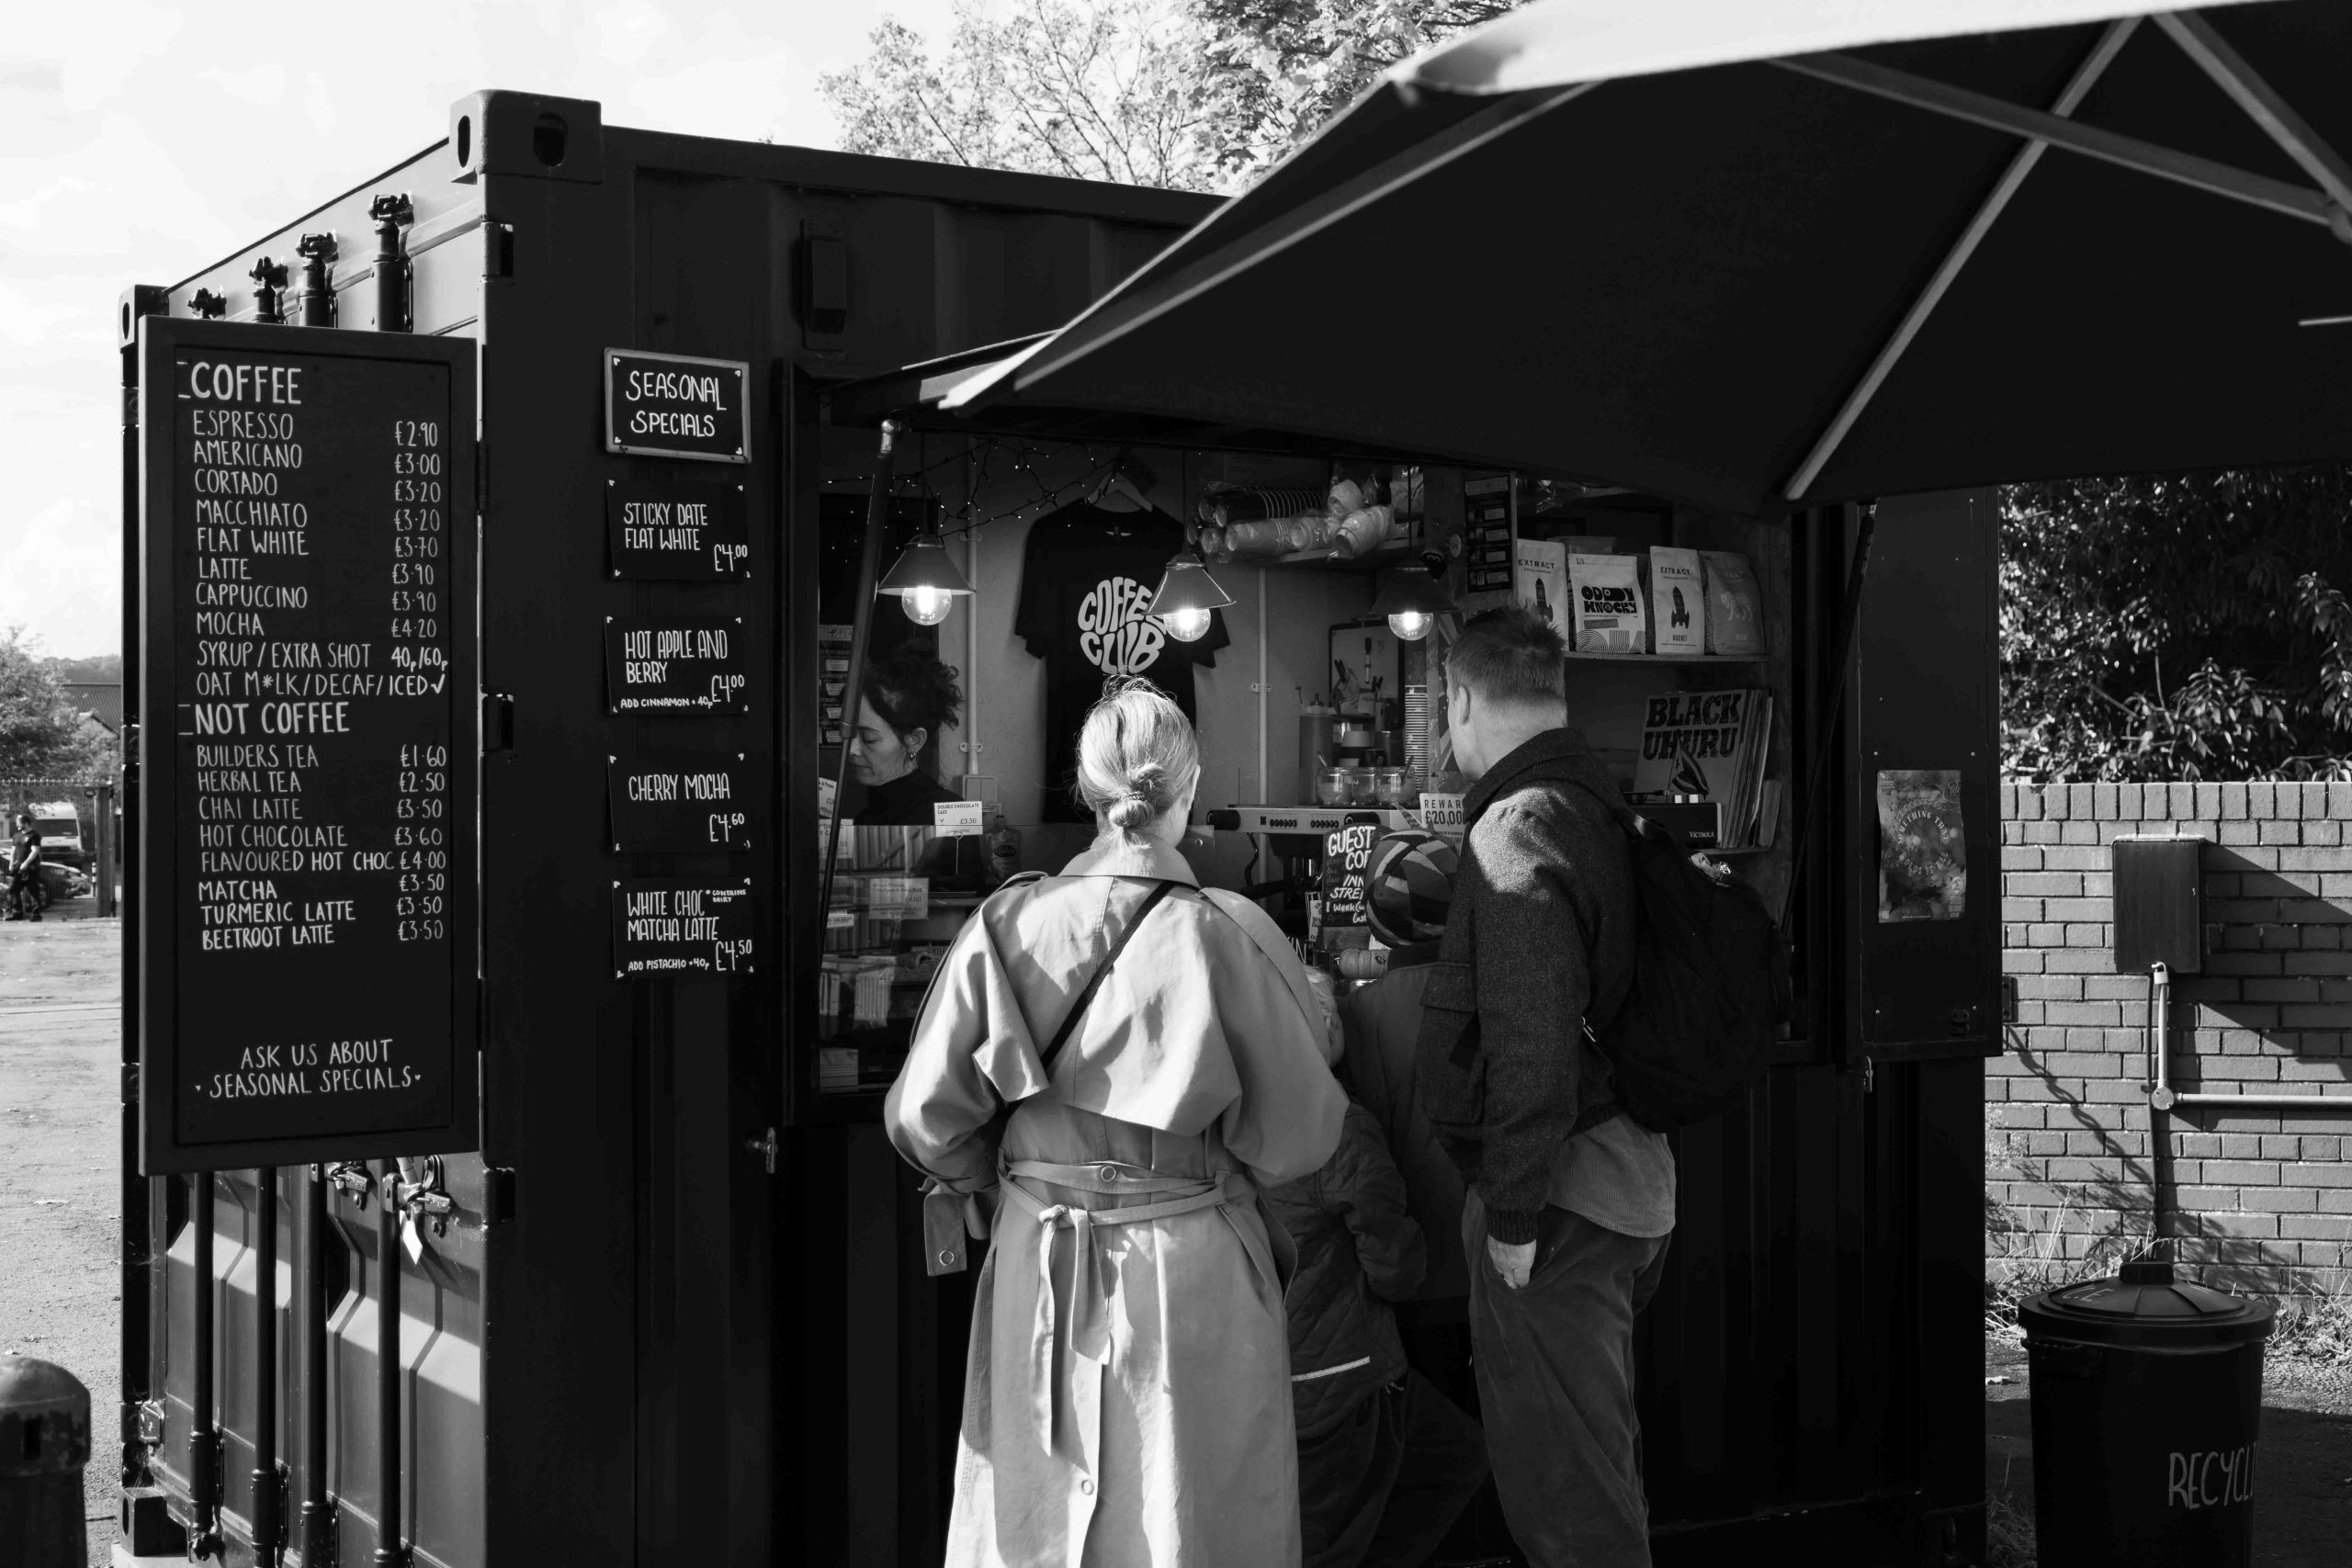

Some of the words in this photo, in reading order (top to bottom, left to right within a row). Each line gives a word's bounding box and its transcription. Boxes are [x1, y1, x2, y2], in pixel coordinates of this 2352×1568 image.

[191, 362, 301, 404] COFFEE
[626, 371, 727, 411] SEASONAL
[194, 411, 293, 439] ESPRESSO
[631, 411, 715, 436] SPECIALS
[195, 440, 301, 468] AMERICANO
[195, 468, 277, 495] CORTADO
[197, 500, 307, 529] MACCHIATO
[624, 503, 670, 525] STICKY
[678, 503, 707, 525] DATE
[198, 527, 241, 551] FLAT
[251, 530, 309, 555] WHITE
[626, 528, 653, 548] FLAT
[660, 528, 700, 550] WHITE
[199, 558, 252, 579] LATTE
[1518, 558, 1555, 569] EXTRACT
[1660, 567, 1690, 575] EXTRACT
[197, 582, 307, 608] CAPPUCCINO
[198, 612, 264, 636] MOCHA
[328, 643, 370, 668] SHOT
[625, 631, 651, 659] HOT
[658, 630, 695, 659] APPLE
[698, 630, 727, 659] AND
[1080, 621, 1165, 674] CLUB
[197, 672, 232, 695] OAT
[627, 661, 667, 682] BERRY
[621, 699, 639, 708] ADD
[641, 698, 689, 706] CINNAMON
[1646, 694, 1742, 728] BLACK
[196, 704, 249, 734] NOT
[262, 702, 349, 733] COFFEE
[198, 745, 278, 767] BUILDERS
[287, 745, 318, 768] TEA
[1643, 728, 1738, 761] UHURU
[198, 771, 261, 792] HERBAL
[267, 772, 301, 792] TEA
[629, 774, 678, 801] CHERRY
[684, 773, 729, 799] MOCHA
[199, 796, 241, 819] CHAI
[254, 798, 302, 819] LATTE
[1425, 800, 1461, 808] REWAR
[1426, 811, 1464, 826] £20,00
[199, 825, 237, 847] HOT
[242, 825, 347, 847] CHOCOLATE
[1328, 826, 1376, 856] GUEST
[202, 851, 303, 872] FLAVOURED
[312, 852, 343, 871] HOT
[354, 852, 394, 870] CHOC
[1346, 850, 1372, 870] COF
[199, 880, 277, 901] MATCHA
[1330, 887, 1363, 899] STRE
[201, 902, 292, 925] TURMERIC
[306, 901, 356, 921] LATTE
[628, 892, 667, 916] WHITE
[675, 890, 705, 916] CHOC
[203, 926, 282, 950] BEETROOT
[293, 924, 334, 944] LATTE
[628, 919, 679, 941] MATCHA
[685, 917, 719, 940] LATTE
[628, 962, 643, 971] ADD
[647, 959, 686, 969] PISTACHIO
[242, 1046, 279, 1069] ASK
[292, 1044, 317, 1066] US
[330, 1039, 392, 1065] ABOUT
[210, 1072, 311, 1098] SEASONAL
[320, 1066, 411, 1092] SPECIALS
